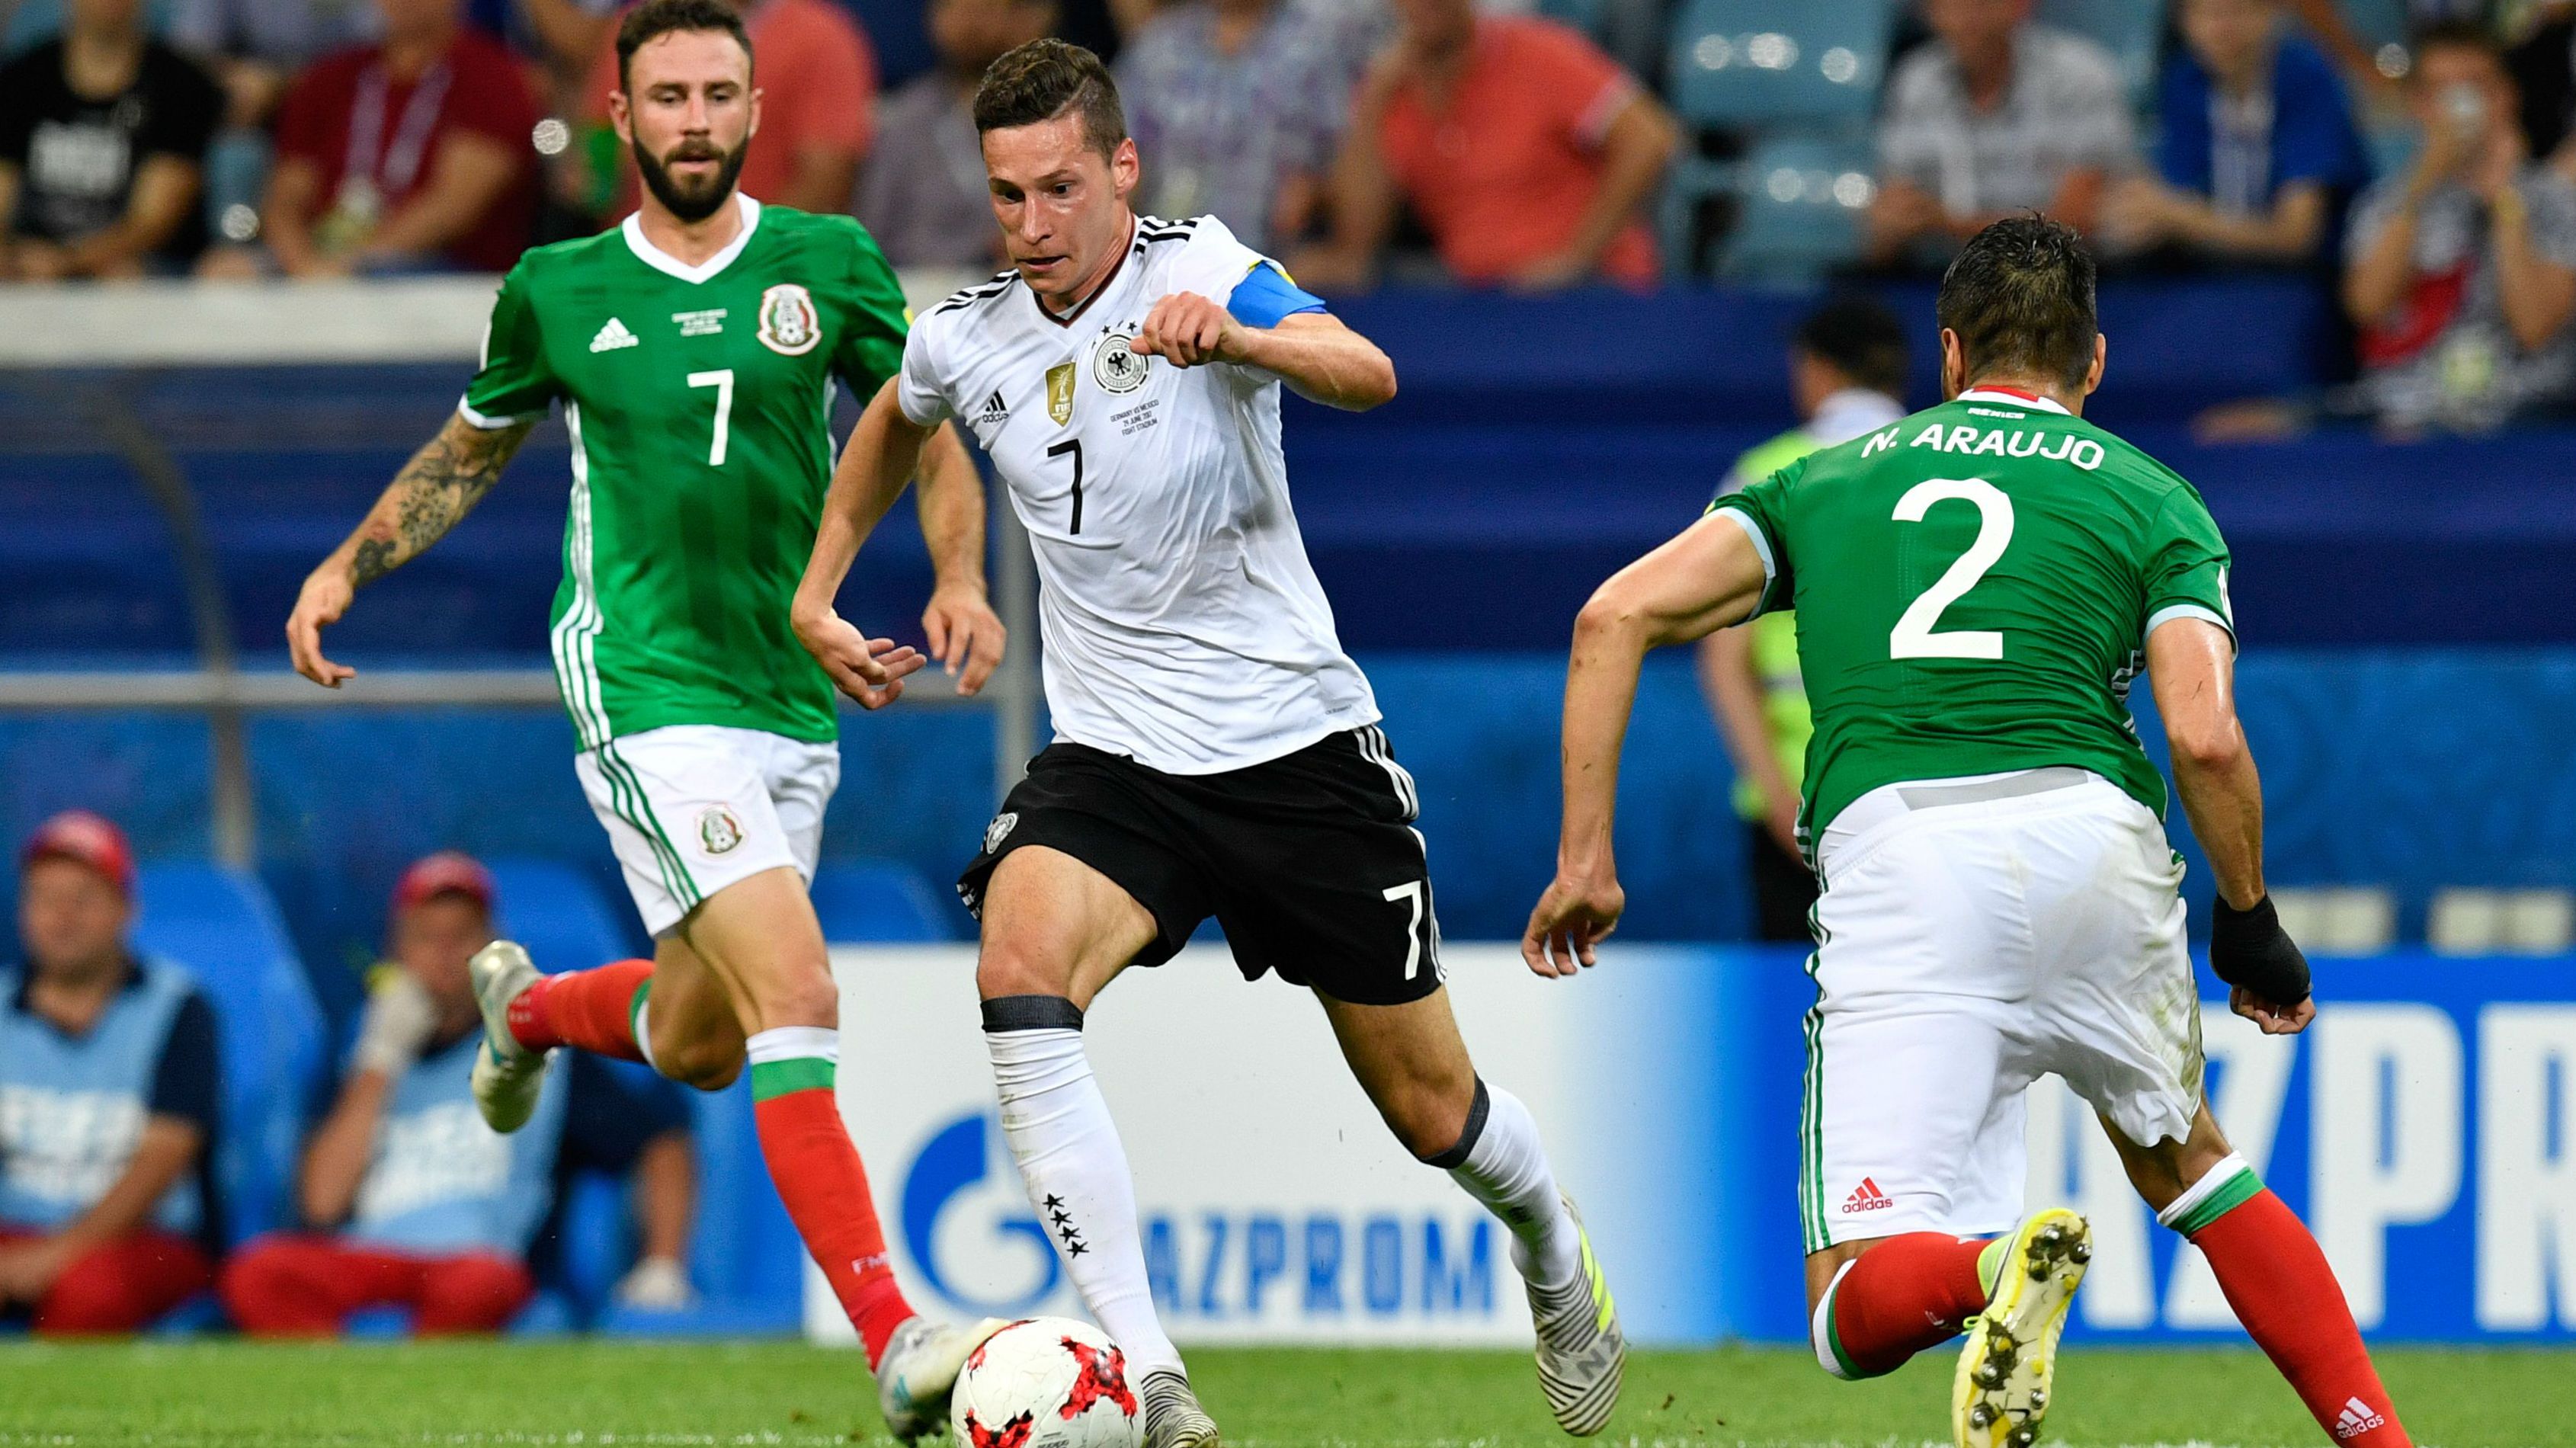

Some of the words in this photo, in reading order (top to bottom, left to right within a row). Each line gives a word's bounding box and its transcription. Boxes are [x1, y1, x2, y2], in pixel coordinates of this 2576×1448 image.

[687, 370, 734, 466] 7
[1861, 427, 1900, 458] N.
[1909, 423, 2106, 471] ARAUJO
[1047, 438, 1083, 535] 7
[1890, 478, 2014, 660] 2
[1382, 879, 1424, 981] 7
[1841, 1197, 1893, 1214] adidas
[2023, 1000, 2576, 1333] AZPR
[1143, 1211, 1496, 1315] AZPROM
[2337, 1414, 2385, 1439] adidas
